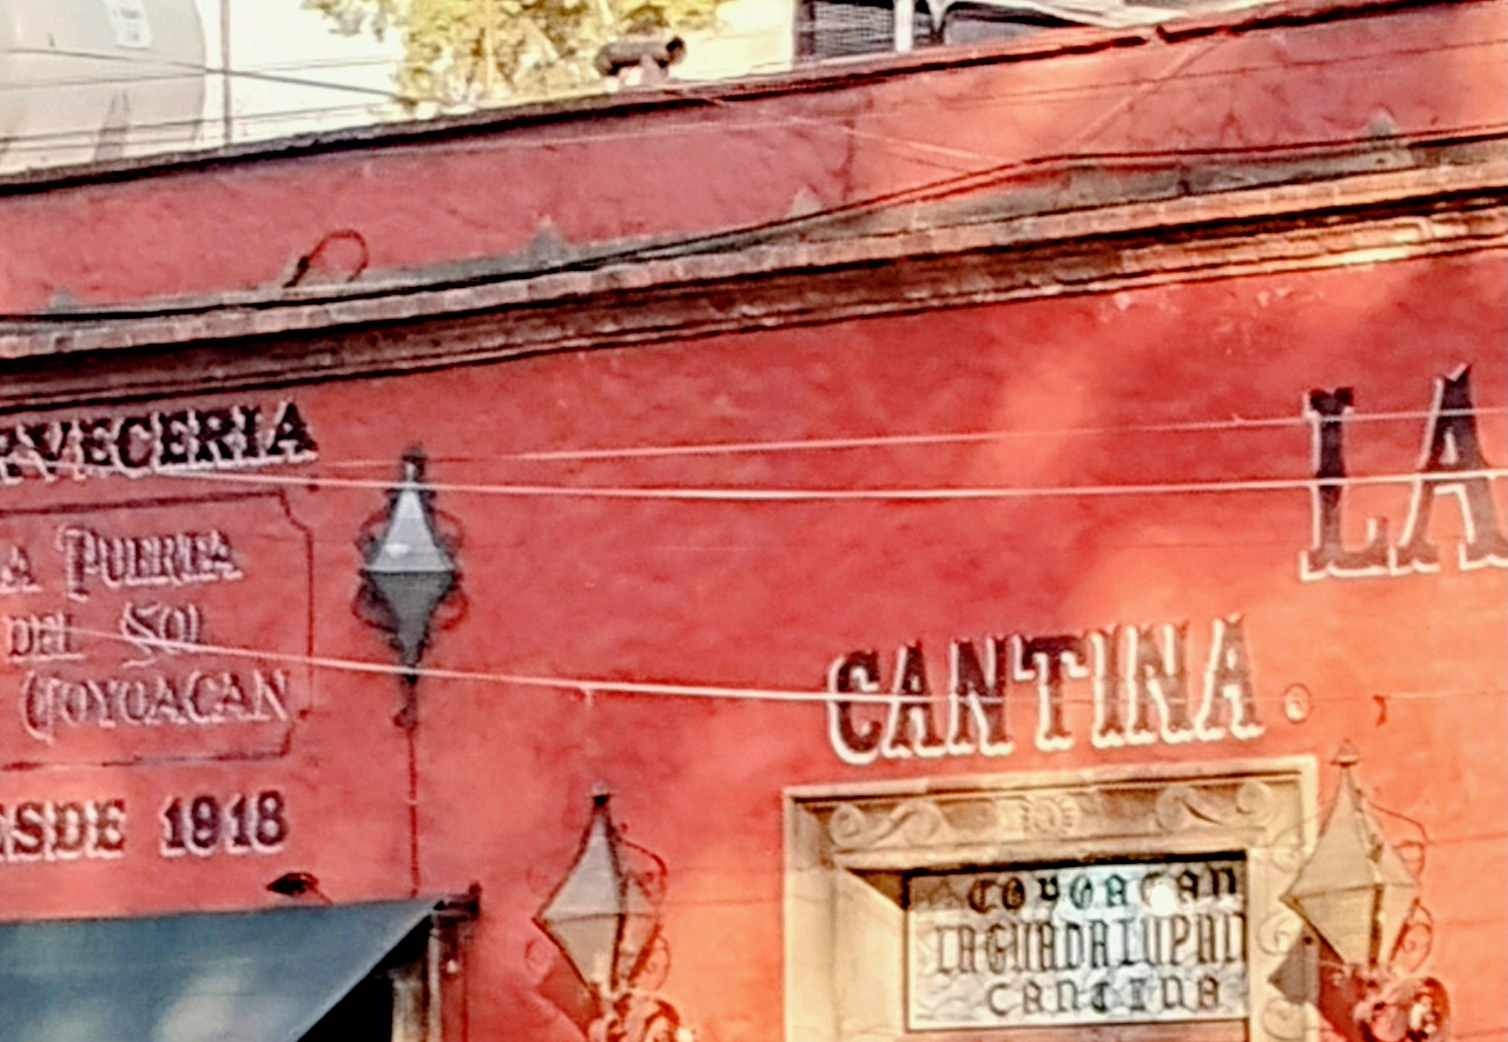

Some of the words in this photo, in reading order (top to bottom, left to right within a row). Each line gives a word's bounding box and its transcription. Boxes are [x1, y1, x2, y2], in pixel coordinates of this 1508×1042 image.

[1300, 363, 1508, 582] LA
[4, 610, 84, 662] DEL
[120, 601, 204, 668] SOL
[828, 613, 1266, 765] CANTINA
[160, 789, 290, 857] 1918
